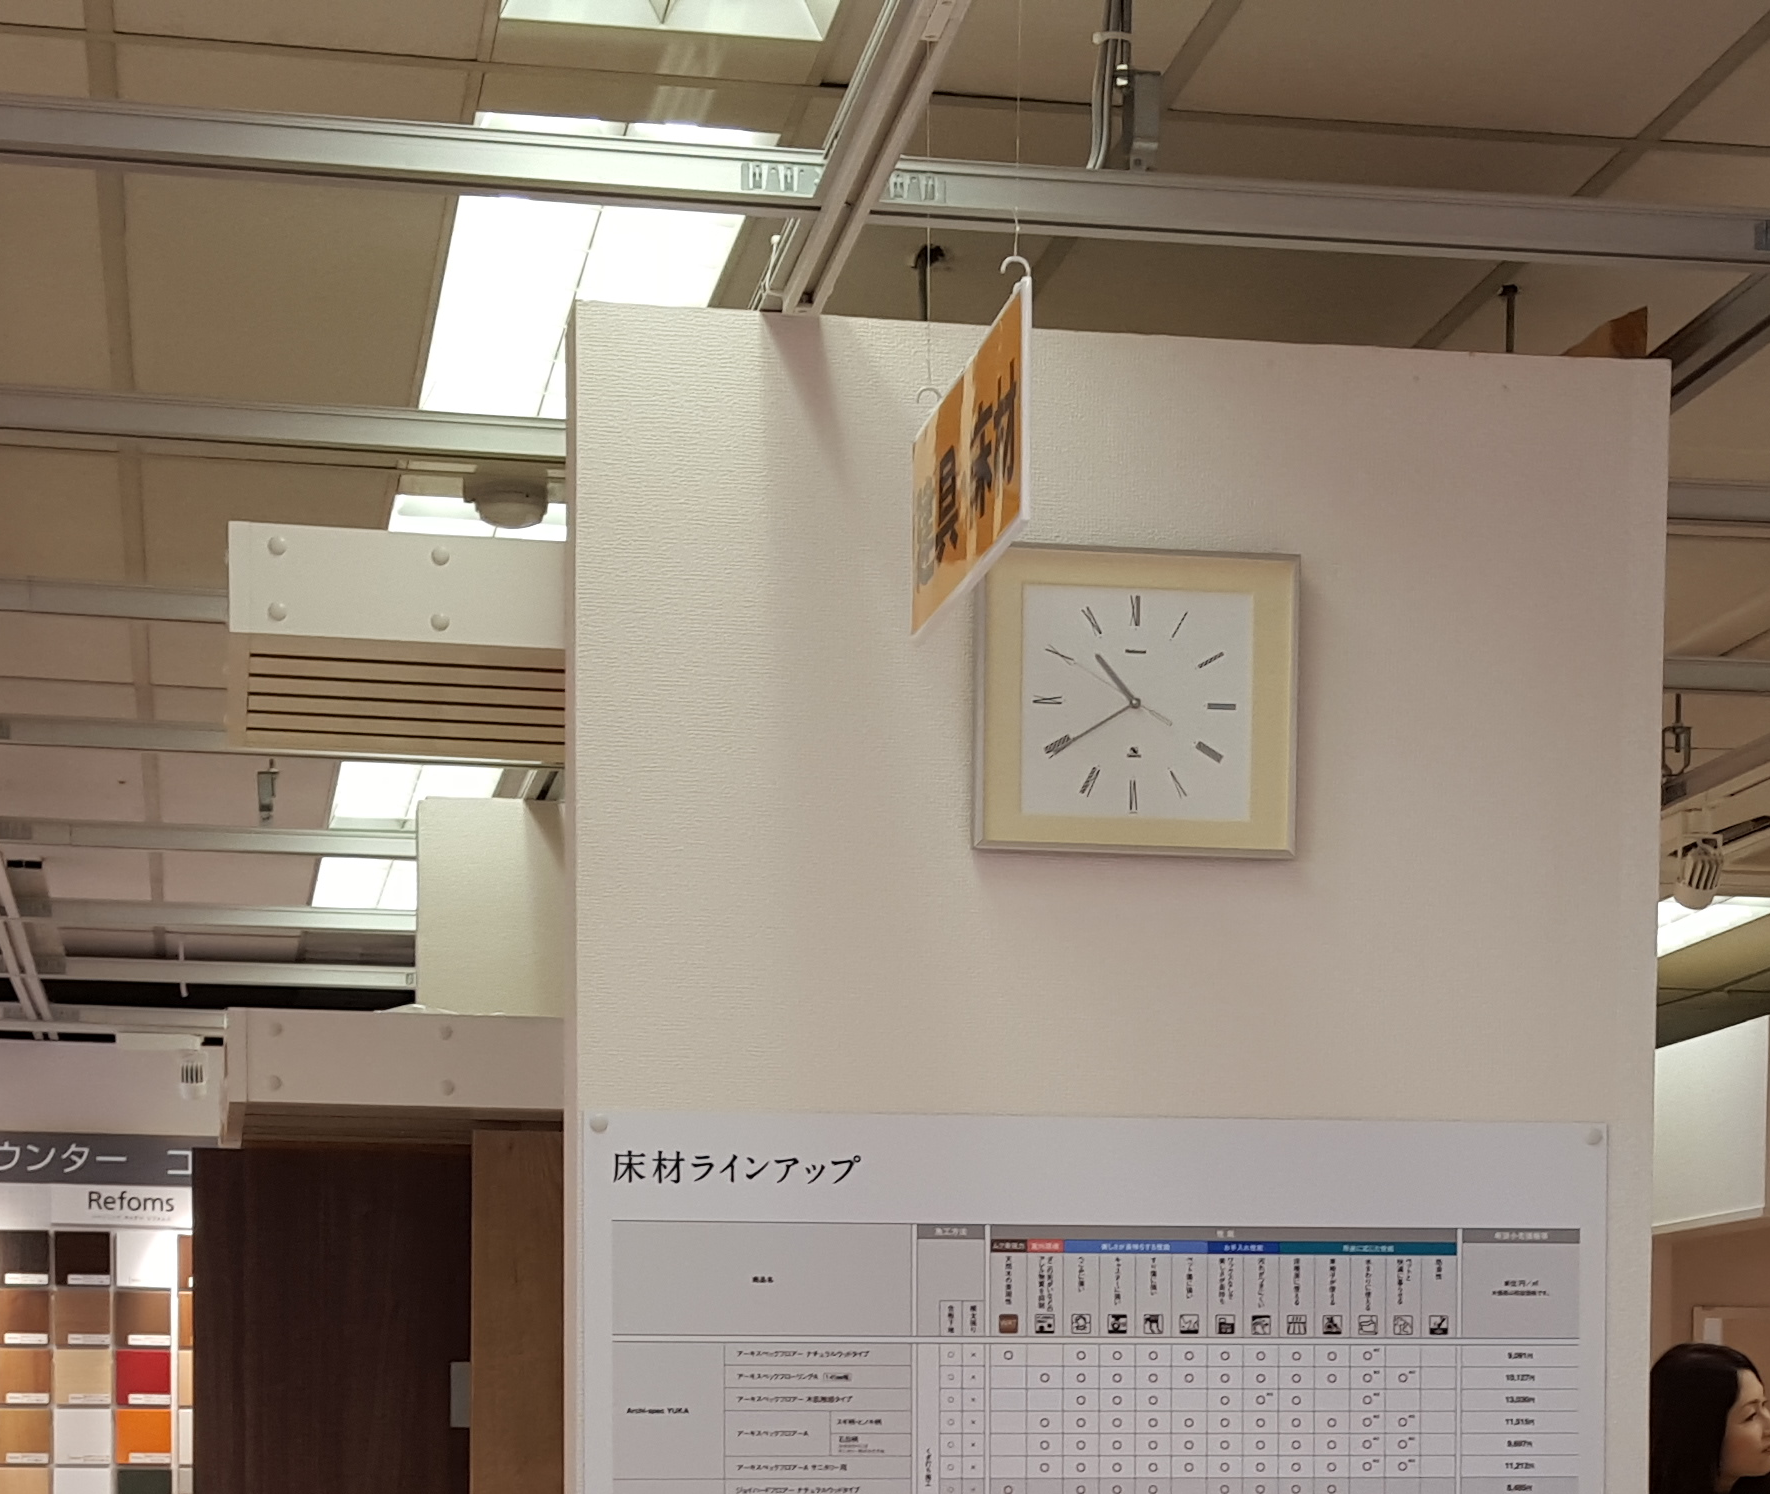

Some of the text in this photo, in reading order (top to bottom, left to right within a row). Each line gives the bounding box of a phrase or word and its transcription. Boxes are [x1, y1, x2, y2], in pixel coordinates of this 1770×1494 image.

[613, 1150, 862, 1185] 床材ラインアップ
[88, 1191, 176, 1213] Refoms
